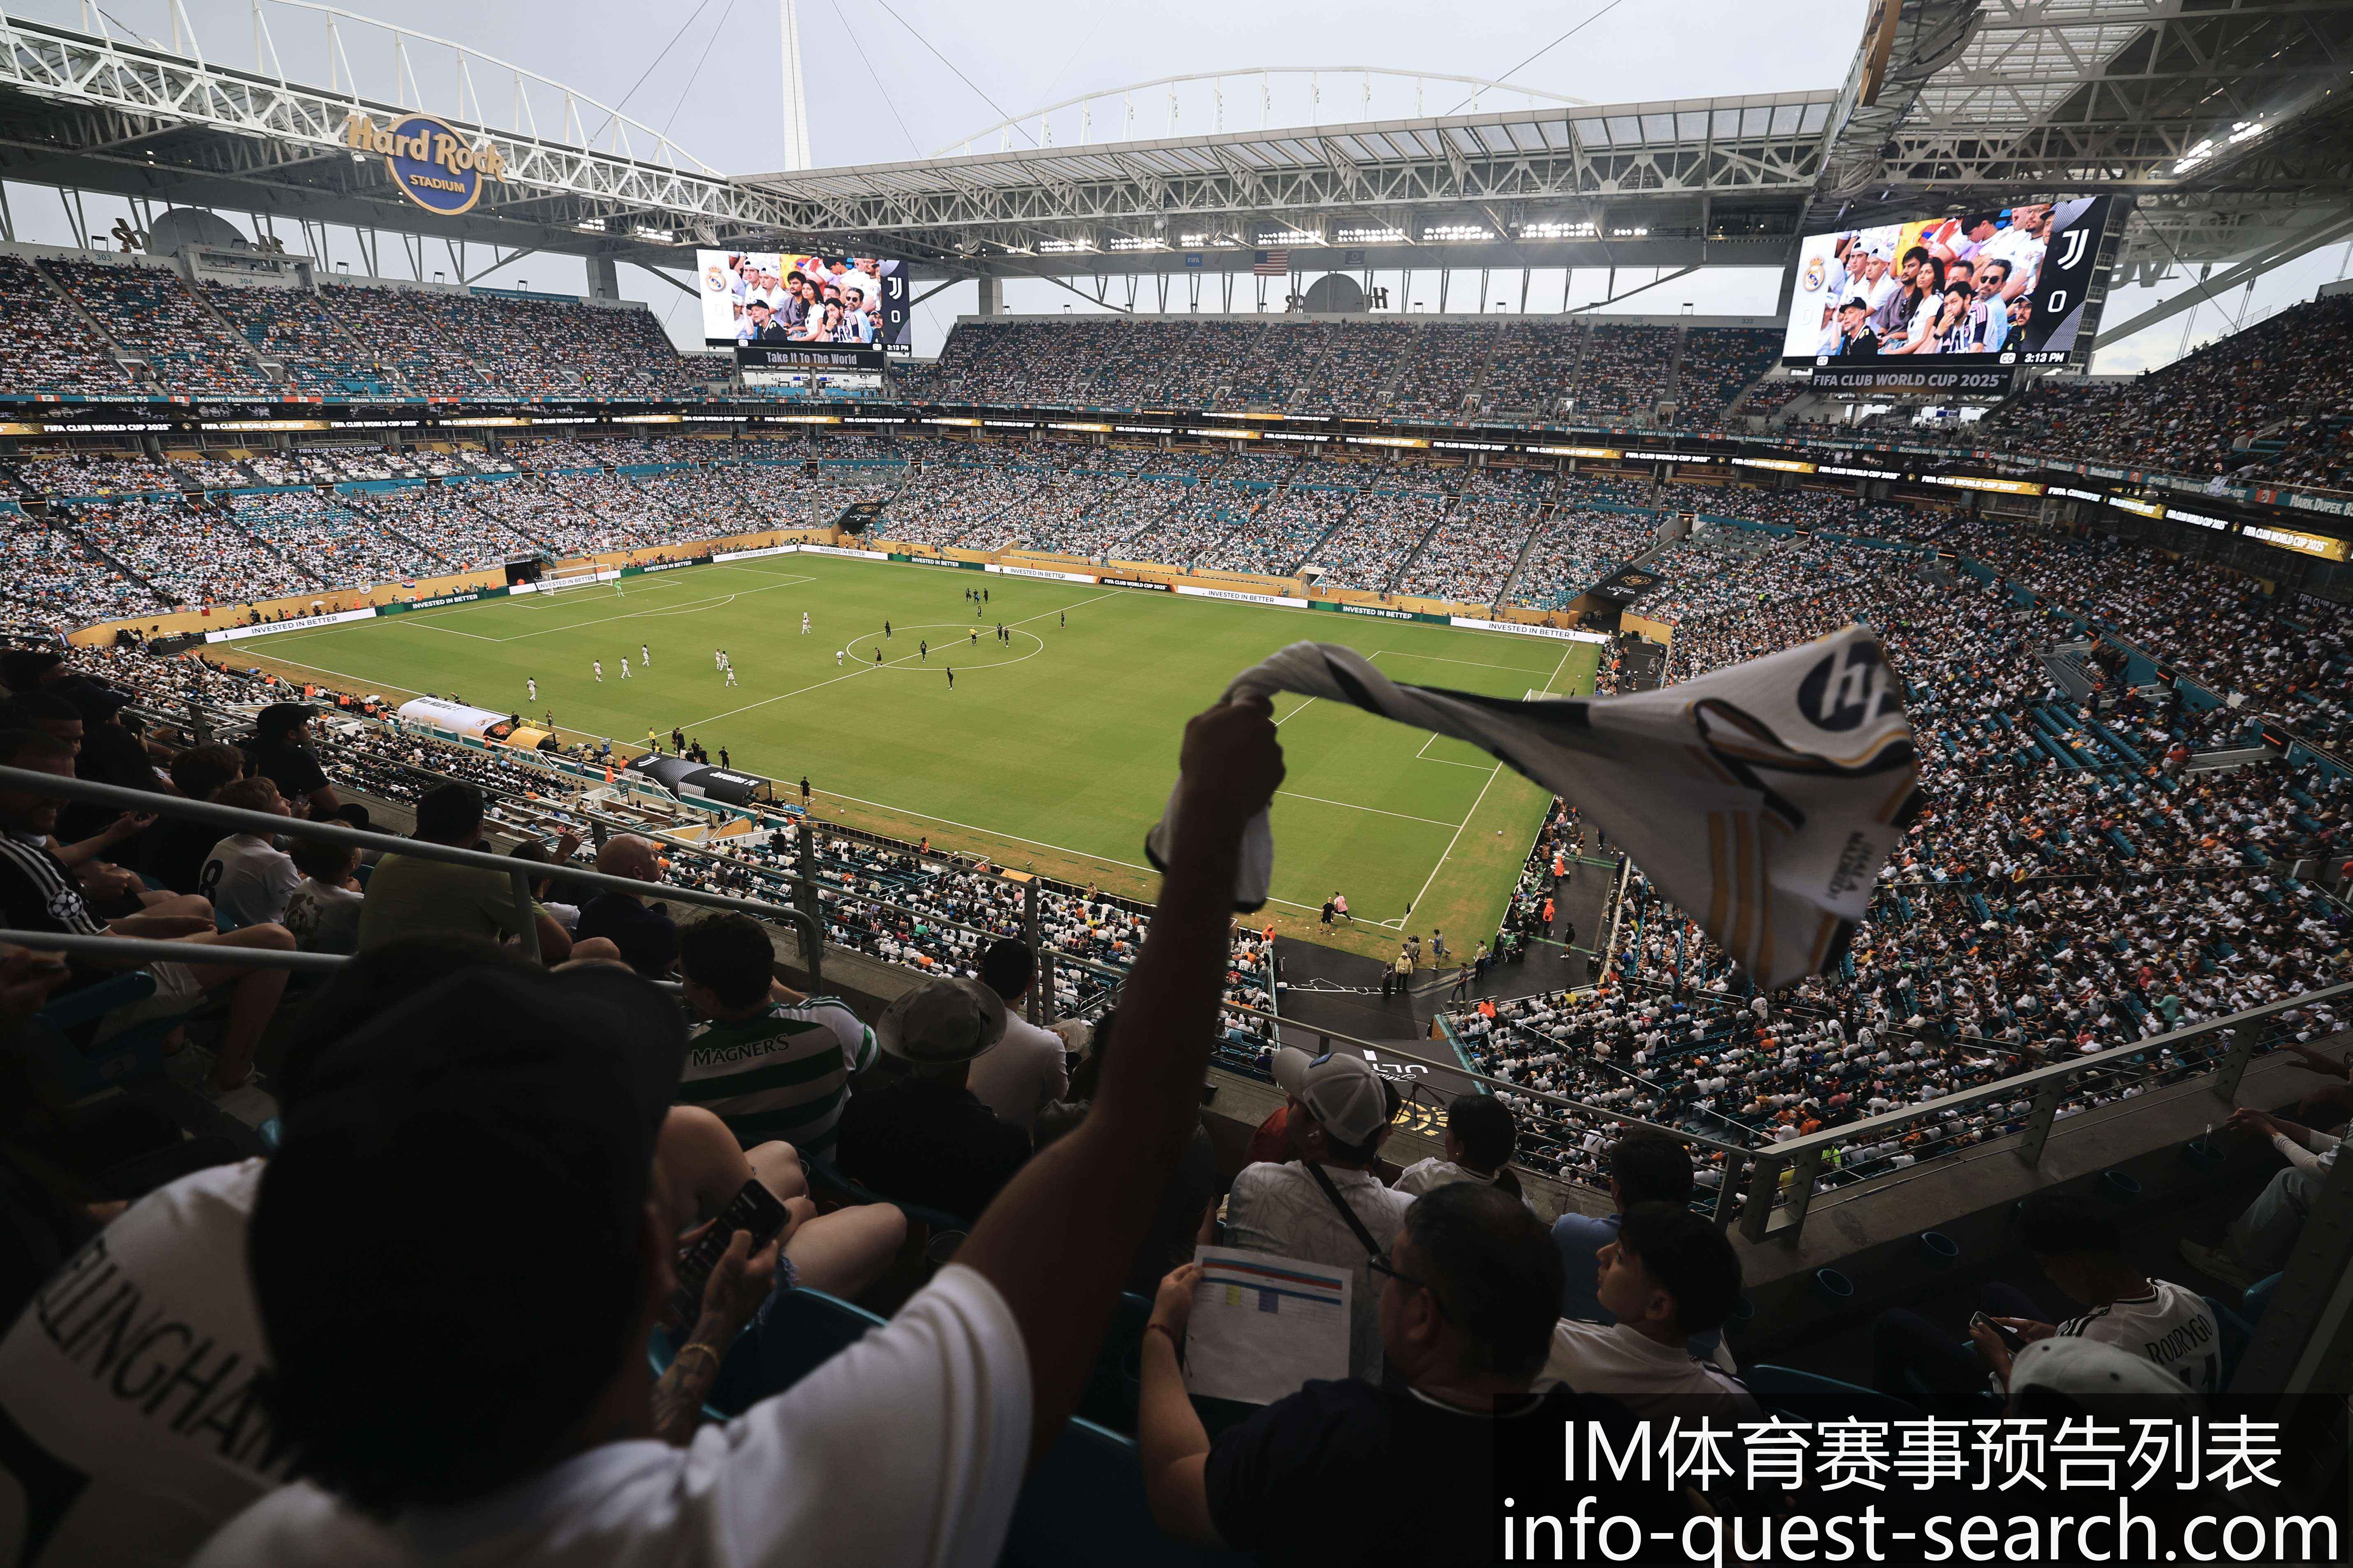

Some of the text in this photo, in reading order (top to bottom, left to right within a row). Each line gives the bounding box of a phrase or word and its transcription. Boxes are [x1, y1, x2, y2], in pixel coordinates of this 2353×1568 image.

[345, 115, 506, 183] Hard Rock
[409, 174, 465, 193] STADIUM
[2047, 290, 2067, 312] 0
[891, 310, 901, 323] 0
[766, 352, 857, 365] Take It To The World
[2024, 352, 2065, 363] 3:13 PM
[1813, 375, 1838, 386] FIFA
[1841, 375, 1873, 386] CLUB
[1876, 374, 1926, 387] WORLD
[1928, 374, 1957, 387] CUP
[2289, 494, 2343, 515] MARK DUPER
[2242, 525, 2256, 537] FIFA
[2255, 528, 2271, 541] CLUB
[2270, 531, 2294, 545] WORLD
[2293, 536, 2307, 548] CUP
[644, 564, 667, 572] INVESTED
[539, 580, 566, 589] INVESTED
[1607, 586, 1635, 594] ULTRA
[412, 599, 445, 609] INVESTED
[454, 594, 478, 603] BETTER
[1209, 590, 1239, 599] INVESTED
[1343, 606, 1376, 615] INVESTED
[1386, 611, 1412, 619] BETTER
[252, 622, 294, 634] INVESTED
[307, 616, 338, 625] BETTER
[1489, 623, 1527, 632] INVESTED
[1540, 628, 1570, 637] BETTER
[709, 772, 748, 784] Juventus
[200, 859, 224, 907] 8
[692, 1033, 790, 1067] MAGNERS
[2144, 1314, 2213, 1365] RODRYGO
